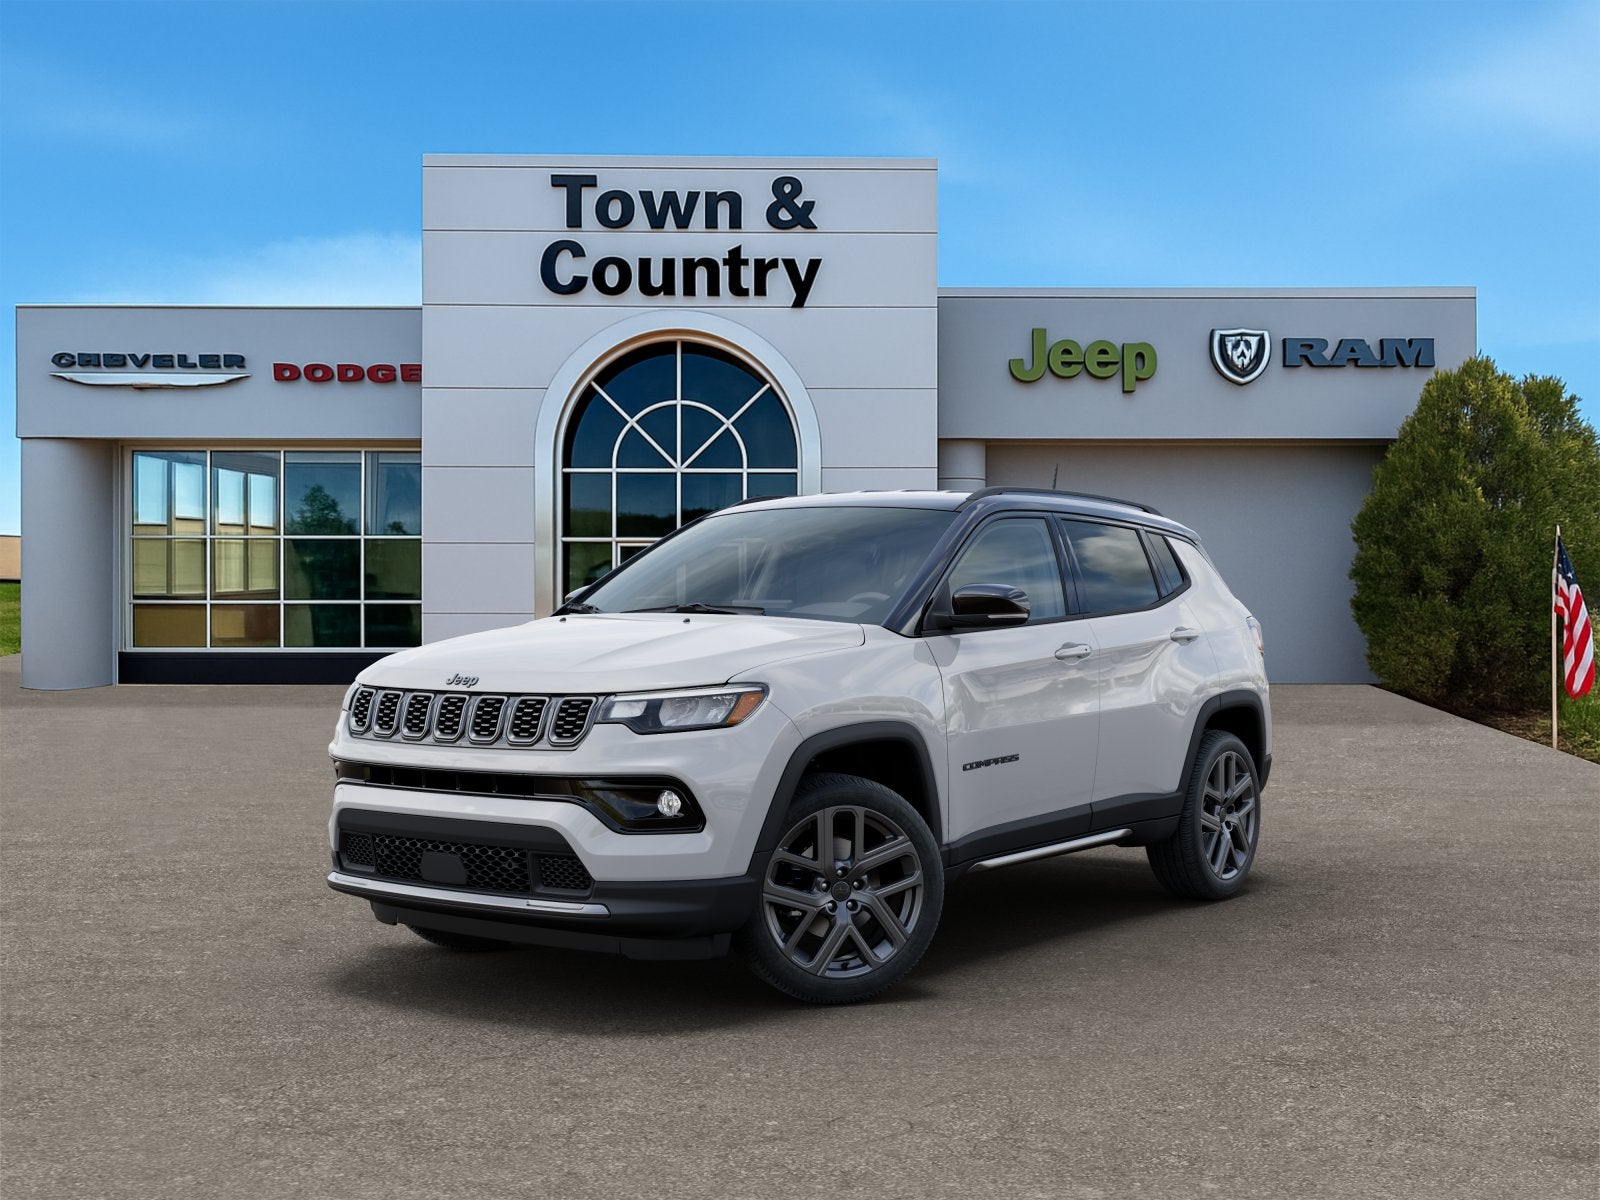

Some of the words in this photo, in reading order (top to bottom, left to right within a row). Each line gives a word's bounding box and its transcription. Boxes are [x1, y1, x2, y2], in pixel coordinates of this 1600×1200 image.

[550, 174, 742, 229] Town
[765, 176, 818, 229] &
[540, 239, 822, 308] Country
[1009, 328, 1157, 392] Jeep
[1282, 337, 1435, 368] RAM
[273, 363, 422, 383] DODGE
[446, 673, 480, 688] Jeep
[962, 753, 1020, 772] COMPASS
